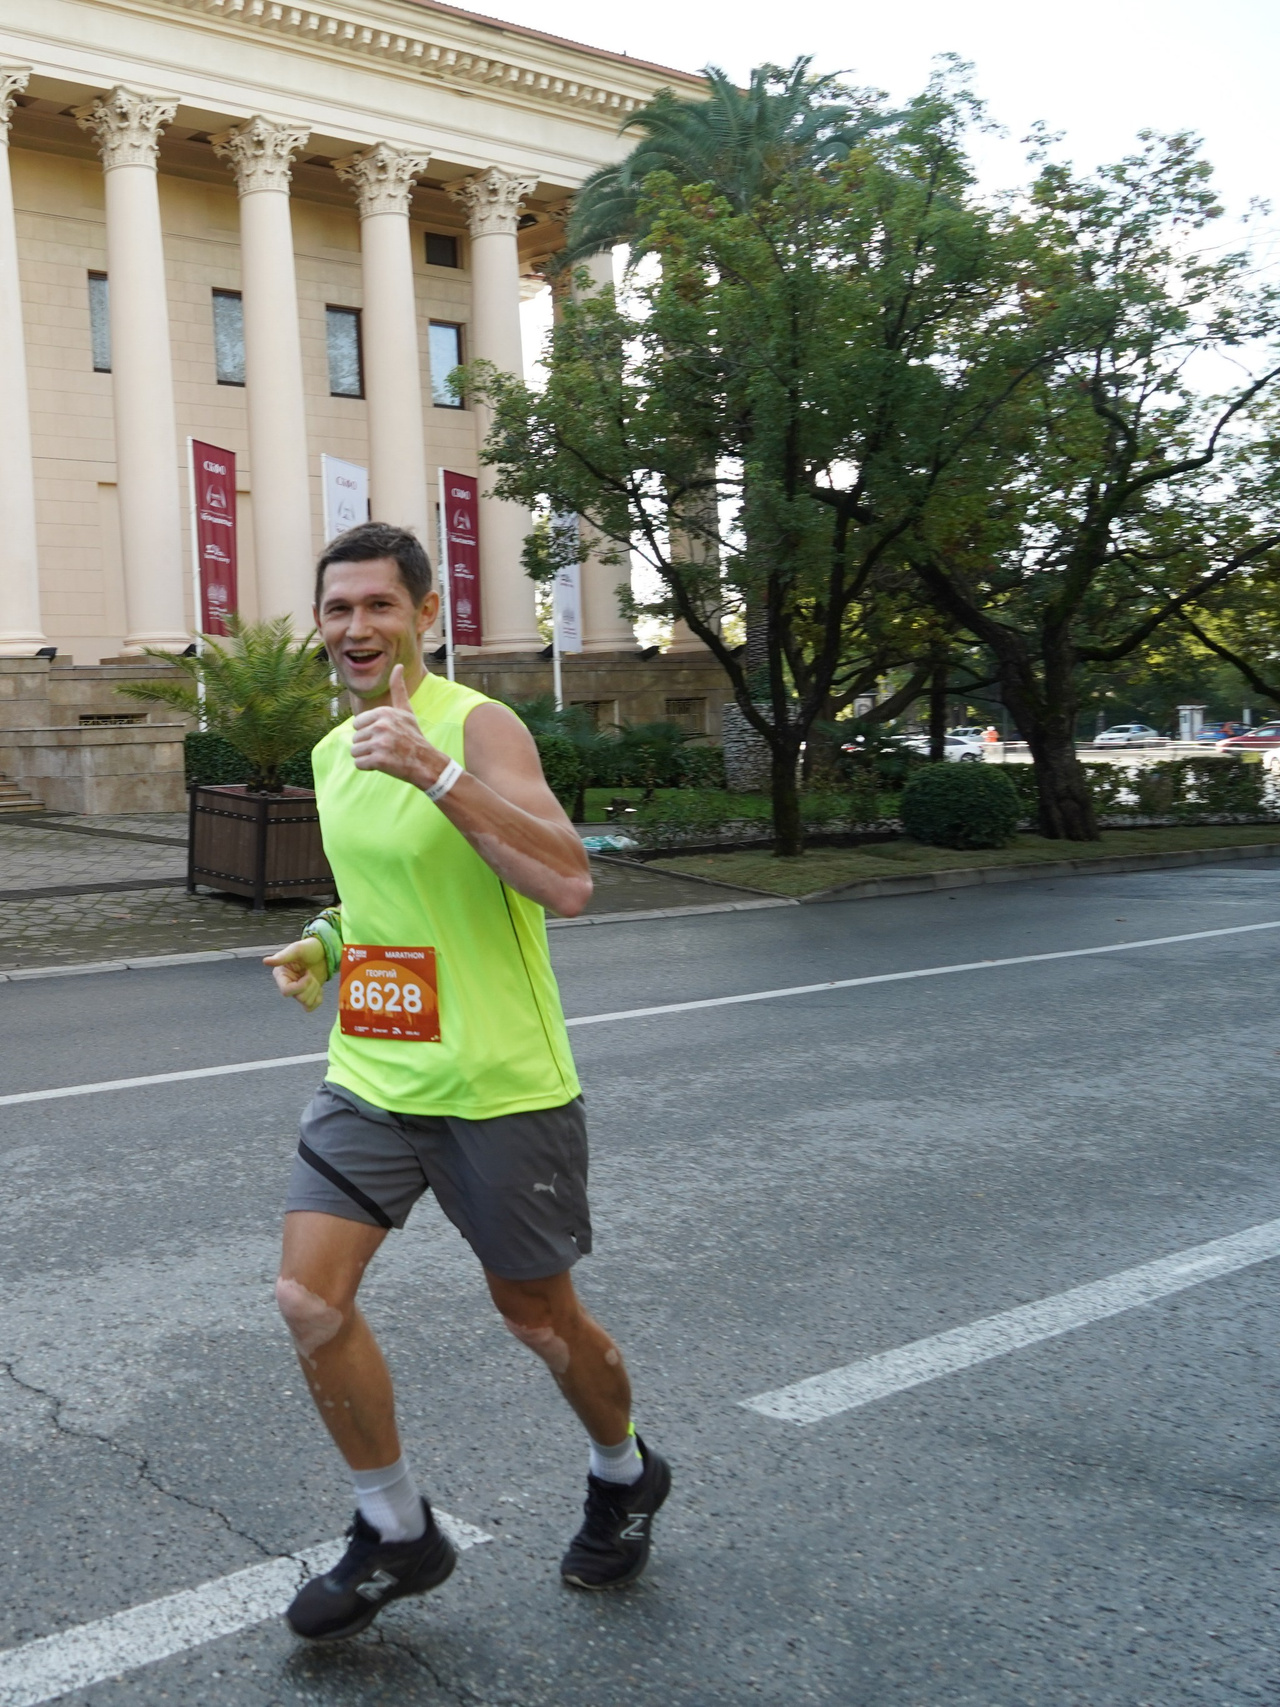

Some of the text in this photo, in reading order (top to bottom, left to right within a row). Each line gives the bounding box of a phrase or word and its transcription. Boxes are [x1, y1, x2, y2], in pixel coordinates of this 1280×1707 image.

[385, 951, 424, 959] MARATHON
[366, 969, 397, 978] ГЕОРГИЙ
[349, 980, 423, 1014] 8628
